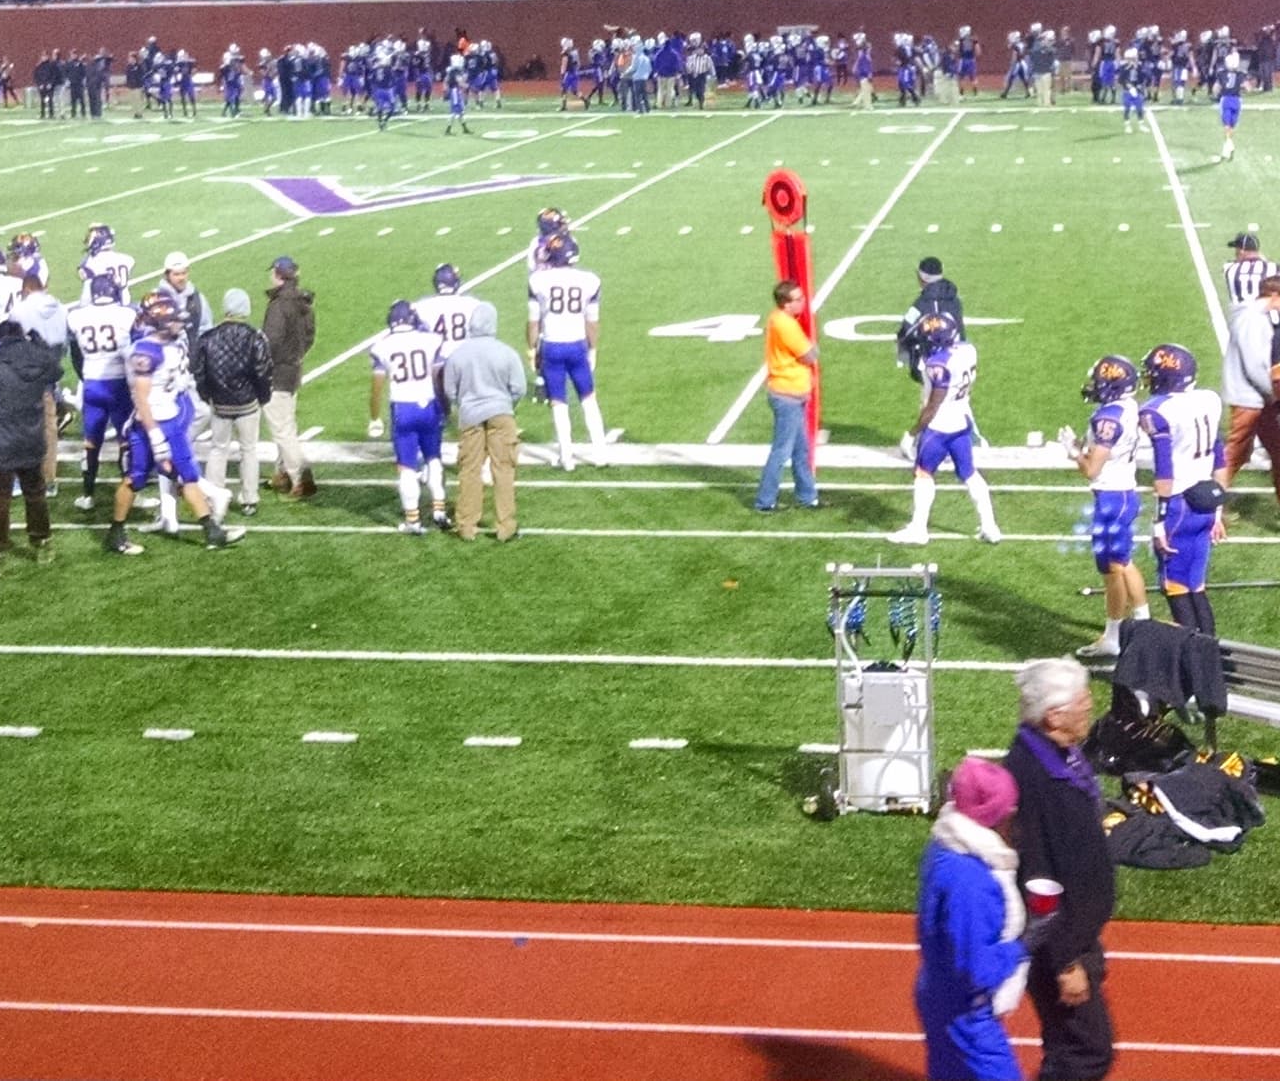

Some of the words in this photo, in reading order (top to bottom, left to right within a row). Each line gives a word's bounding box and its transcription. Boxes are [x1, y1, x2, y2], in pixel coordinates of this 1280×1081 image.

[550, 286, 582, 314] 88
[81, 325, 118, 354] 33
[433, 313, 466, 342] 48
[390, 349, 428, 384] 30
[1193, 414, 1212, 460] 11
